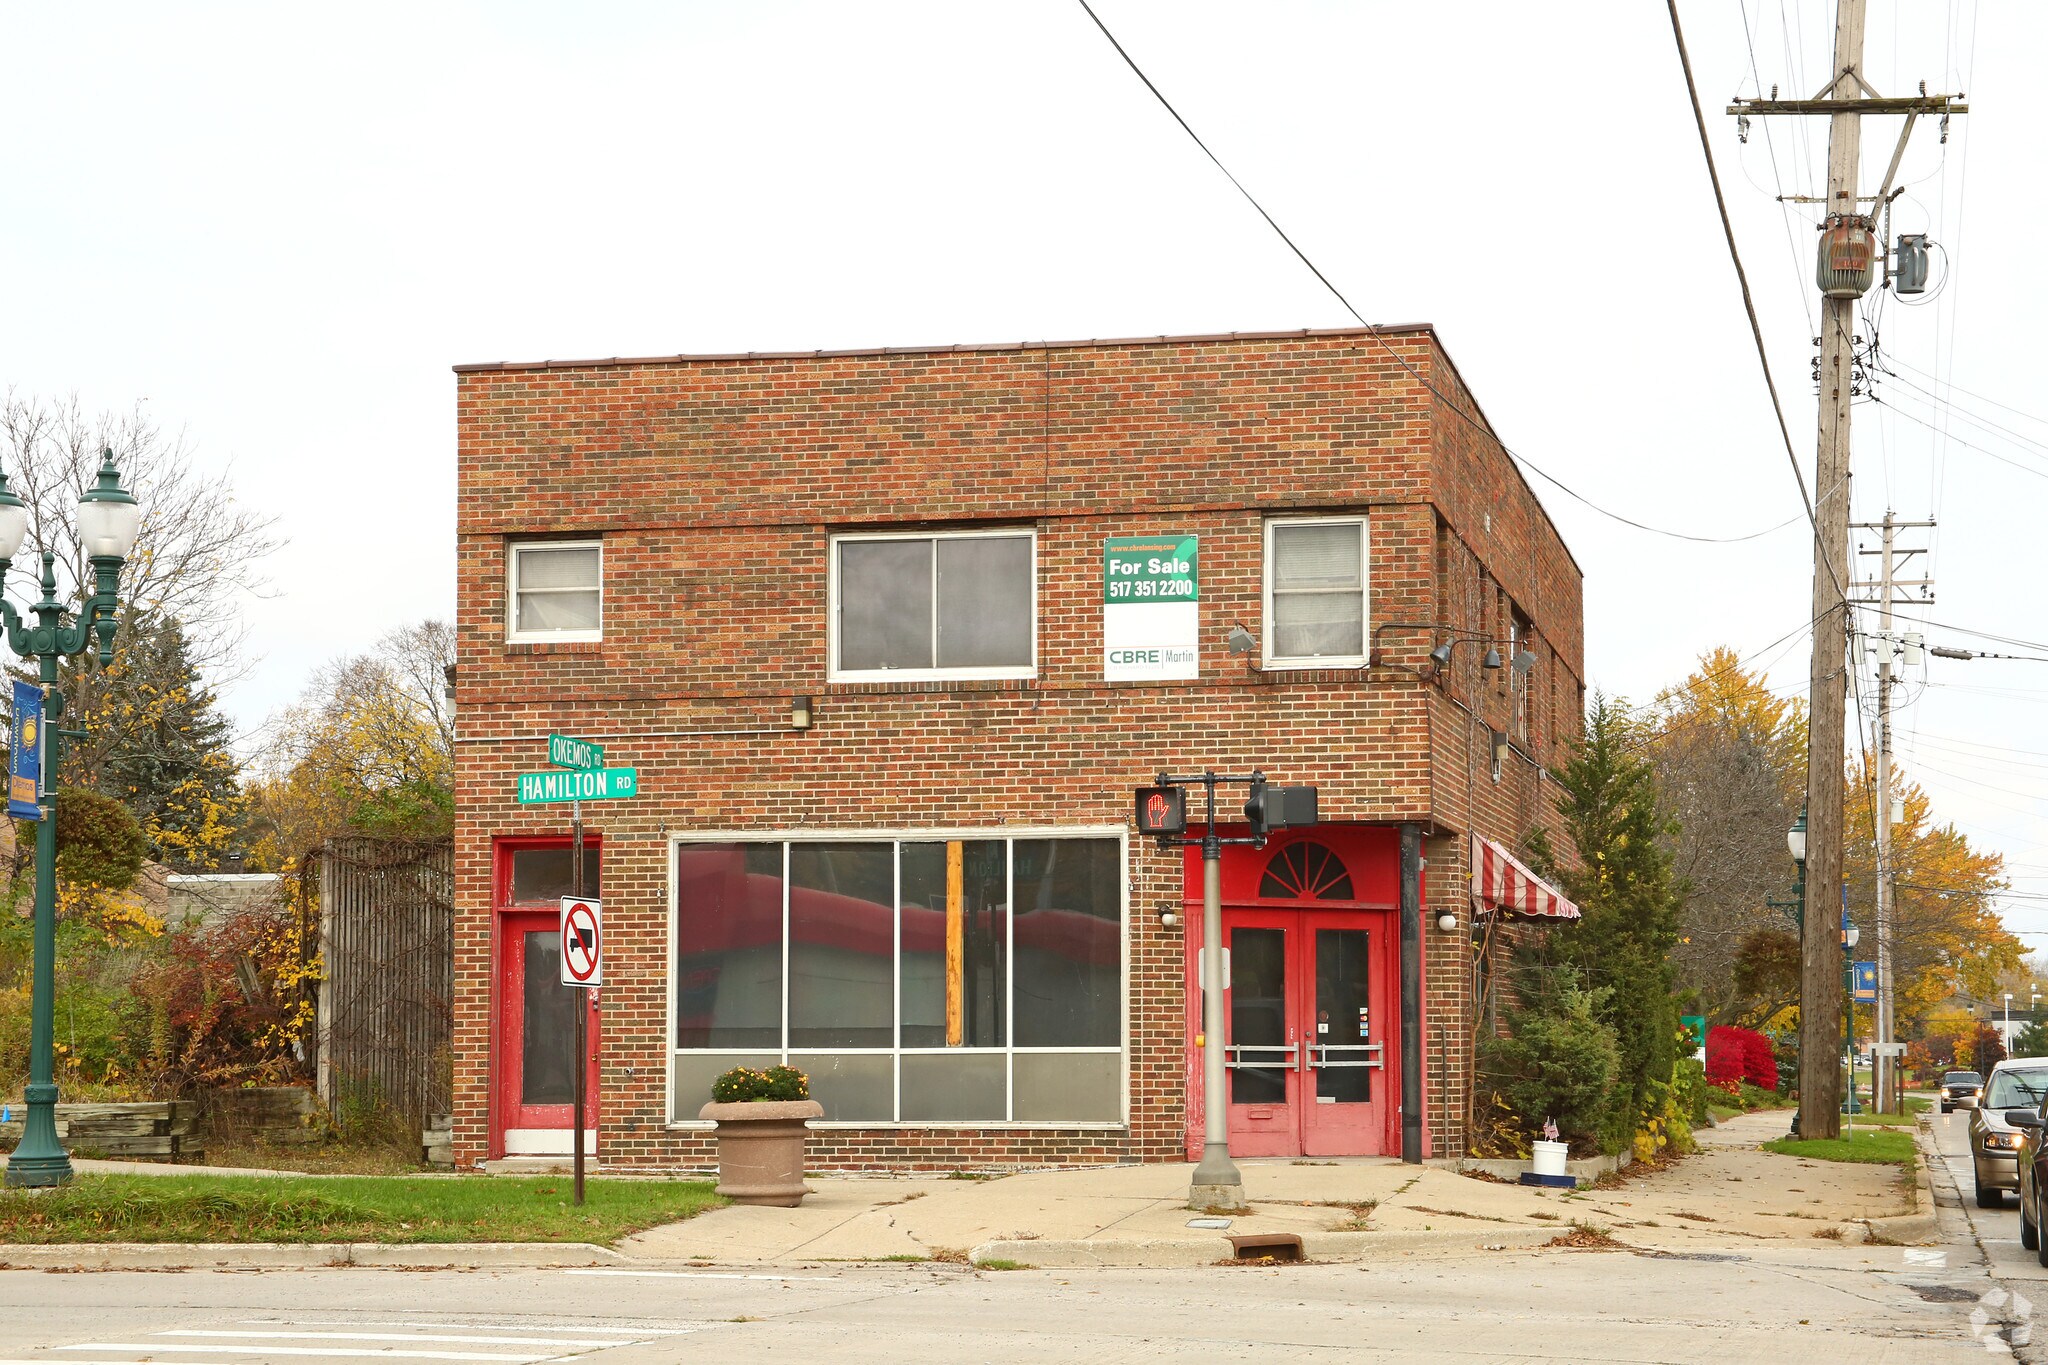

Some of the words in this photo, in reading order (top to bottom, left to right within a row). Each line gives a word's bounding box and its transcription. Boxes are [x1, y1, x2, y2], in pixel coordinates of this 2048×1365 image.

[1109, 559, 1142, 575] For
[1147, 558, 1190, 574] Sale
[1109, 581, 1131, 597] 517
[1134, 581, 1156, 596] 351
[1159, 580, 1193, 595] 2200
[1109, 650, 1160, 664] CBRE
[1165, 650, 1194, 662] Martin
[553, 737, 591, 769] OKEMOS
[594, 753, 601, 766] RD
[522, 772, 607, 801] HAMILTON
[616, 776, 631, 789] RD
